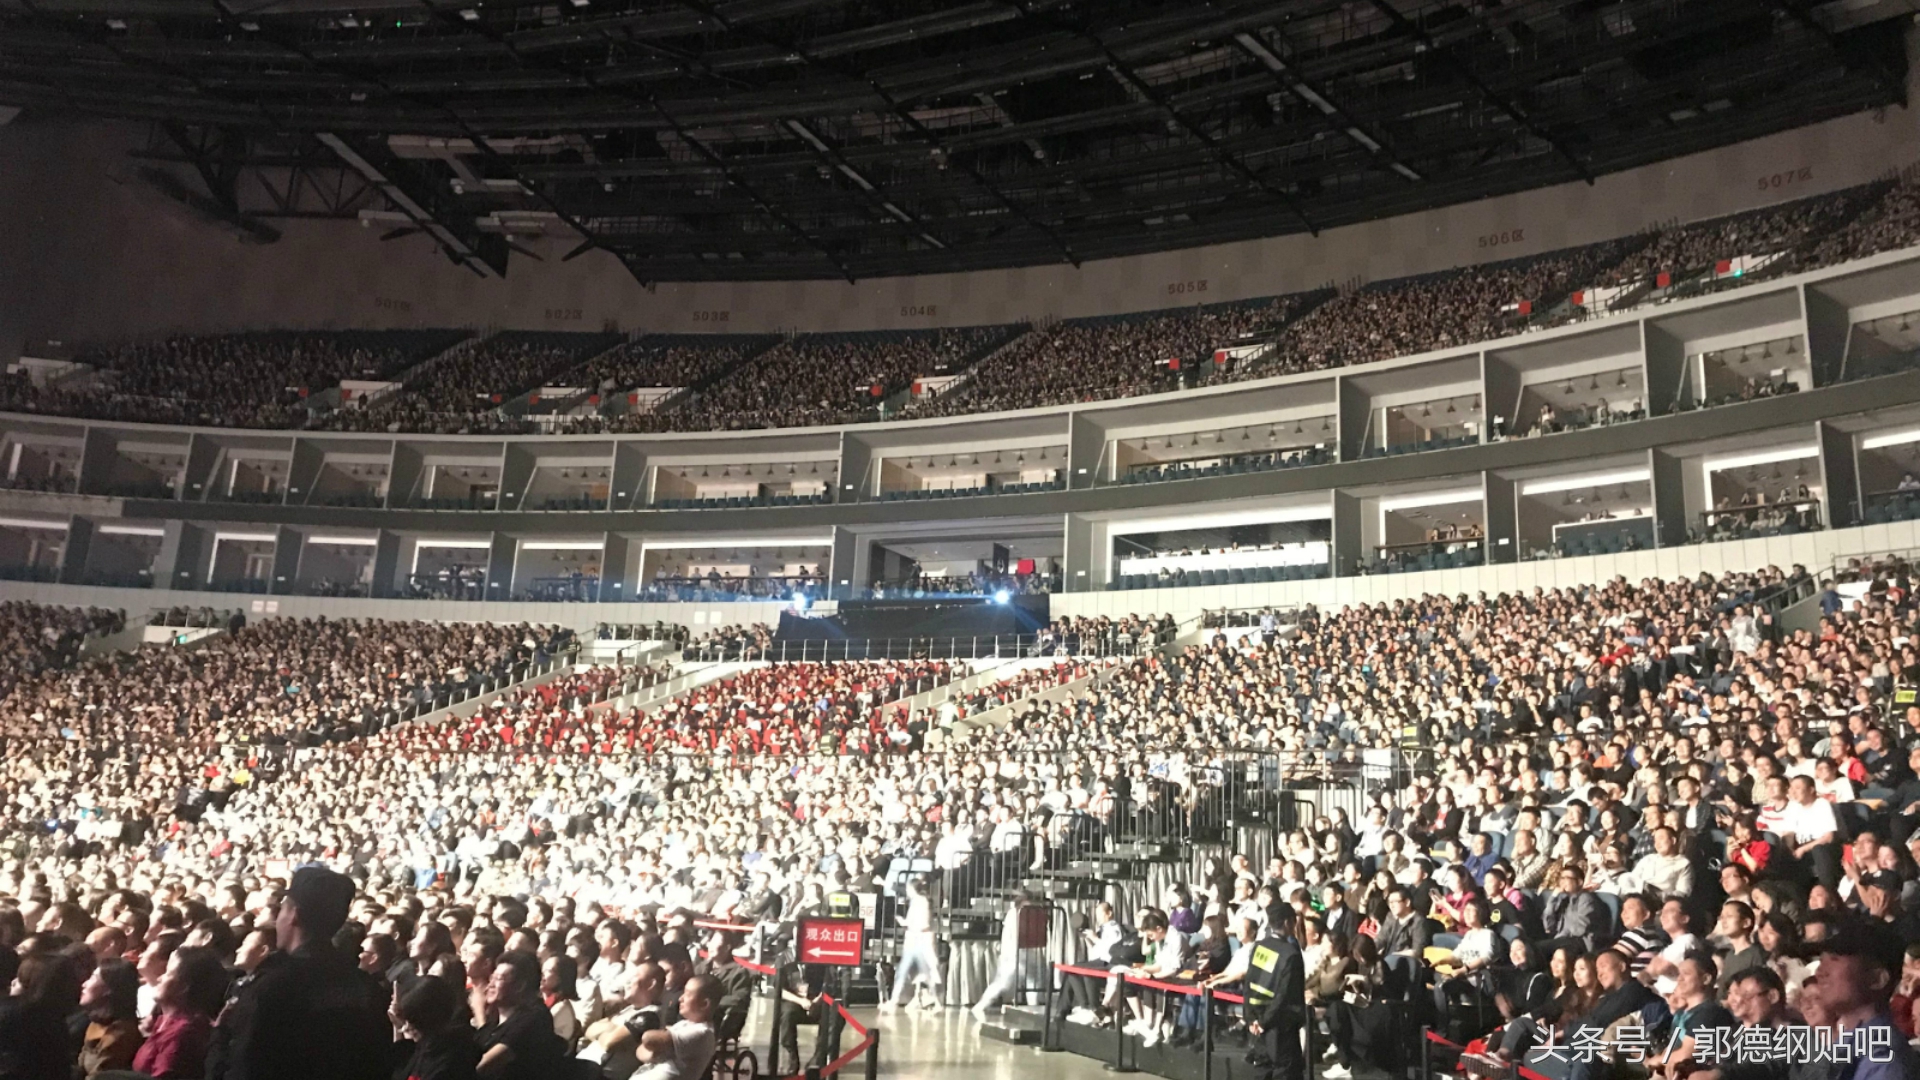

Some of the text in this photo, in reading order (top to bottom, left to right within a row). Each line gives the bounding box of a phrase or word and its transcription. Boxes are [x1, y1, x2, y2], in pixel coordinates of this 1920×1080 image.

[1758, 166, 1813, 190] 507区
[1478, 229, 1524, 248] 506区
[1168, 280, 1207, 295] 505区
[692, 311, 730, 322] 503区
[900, 305, 937, 317] 504区
[806, 927, 858, 943] 观众出口
